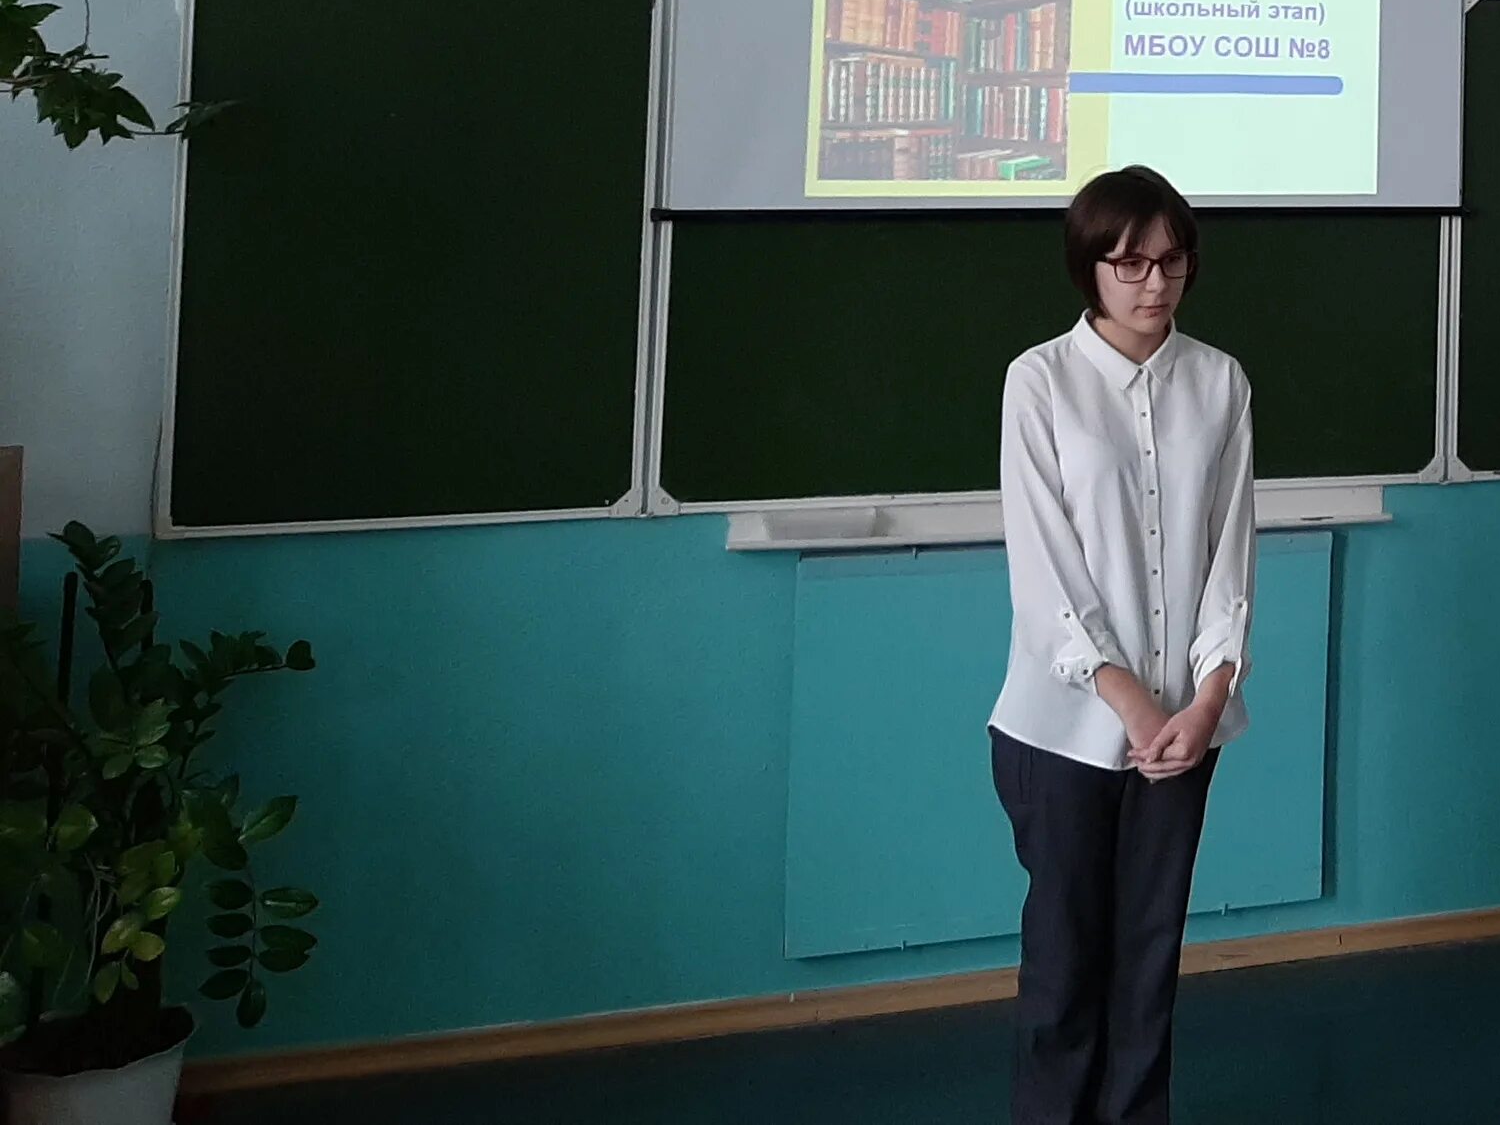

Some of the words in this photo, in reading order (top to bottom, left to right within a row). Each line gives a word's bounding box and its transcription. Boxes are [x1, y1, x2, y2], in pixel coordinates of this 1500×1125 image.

[1268, 2, 1325, 26] этап)
[1124, 34, 1206, 57] МБОУ
[1214, 35, 1280, 58] СОШ
[1289, 37, 1331, 60] №8
